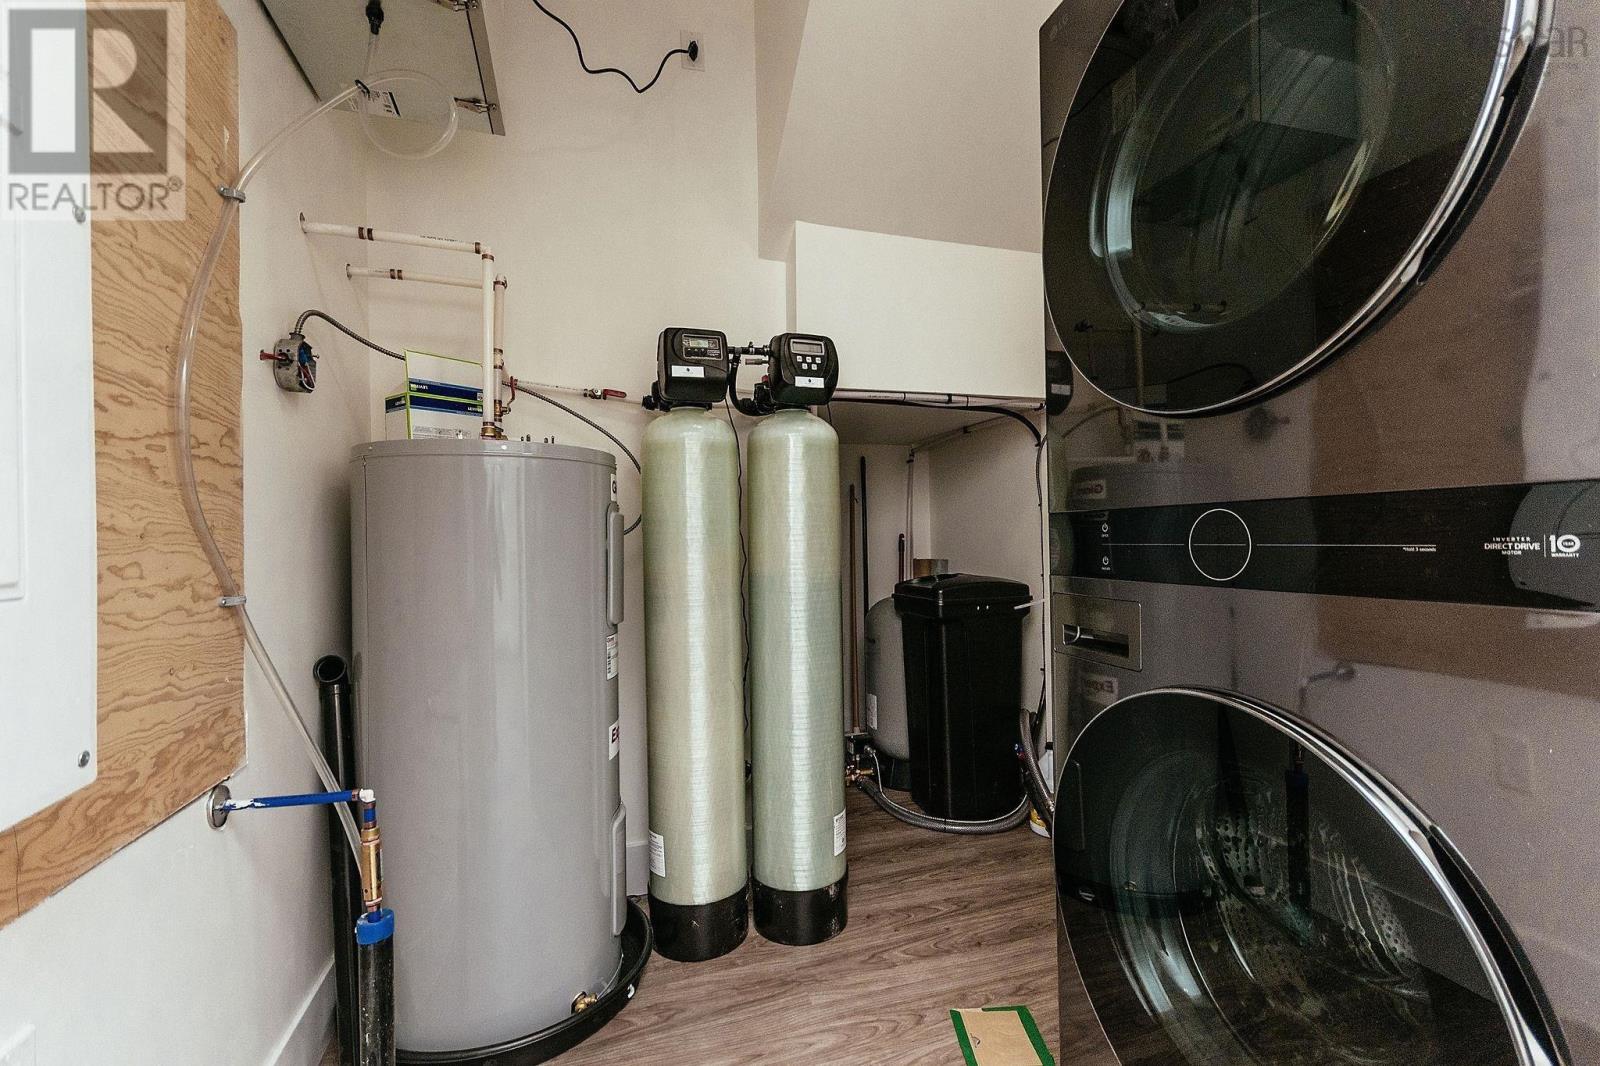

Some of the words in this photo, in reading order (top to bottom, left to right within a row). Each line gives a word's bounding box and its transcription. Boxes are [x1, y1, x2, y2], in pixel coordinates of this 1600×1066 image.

[1484, 542, 1513, 550] DIRECT
[1514, 542, 1541, 551] DRIVE
[1549, 534, 1580, 553] 10
